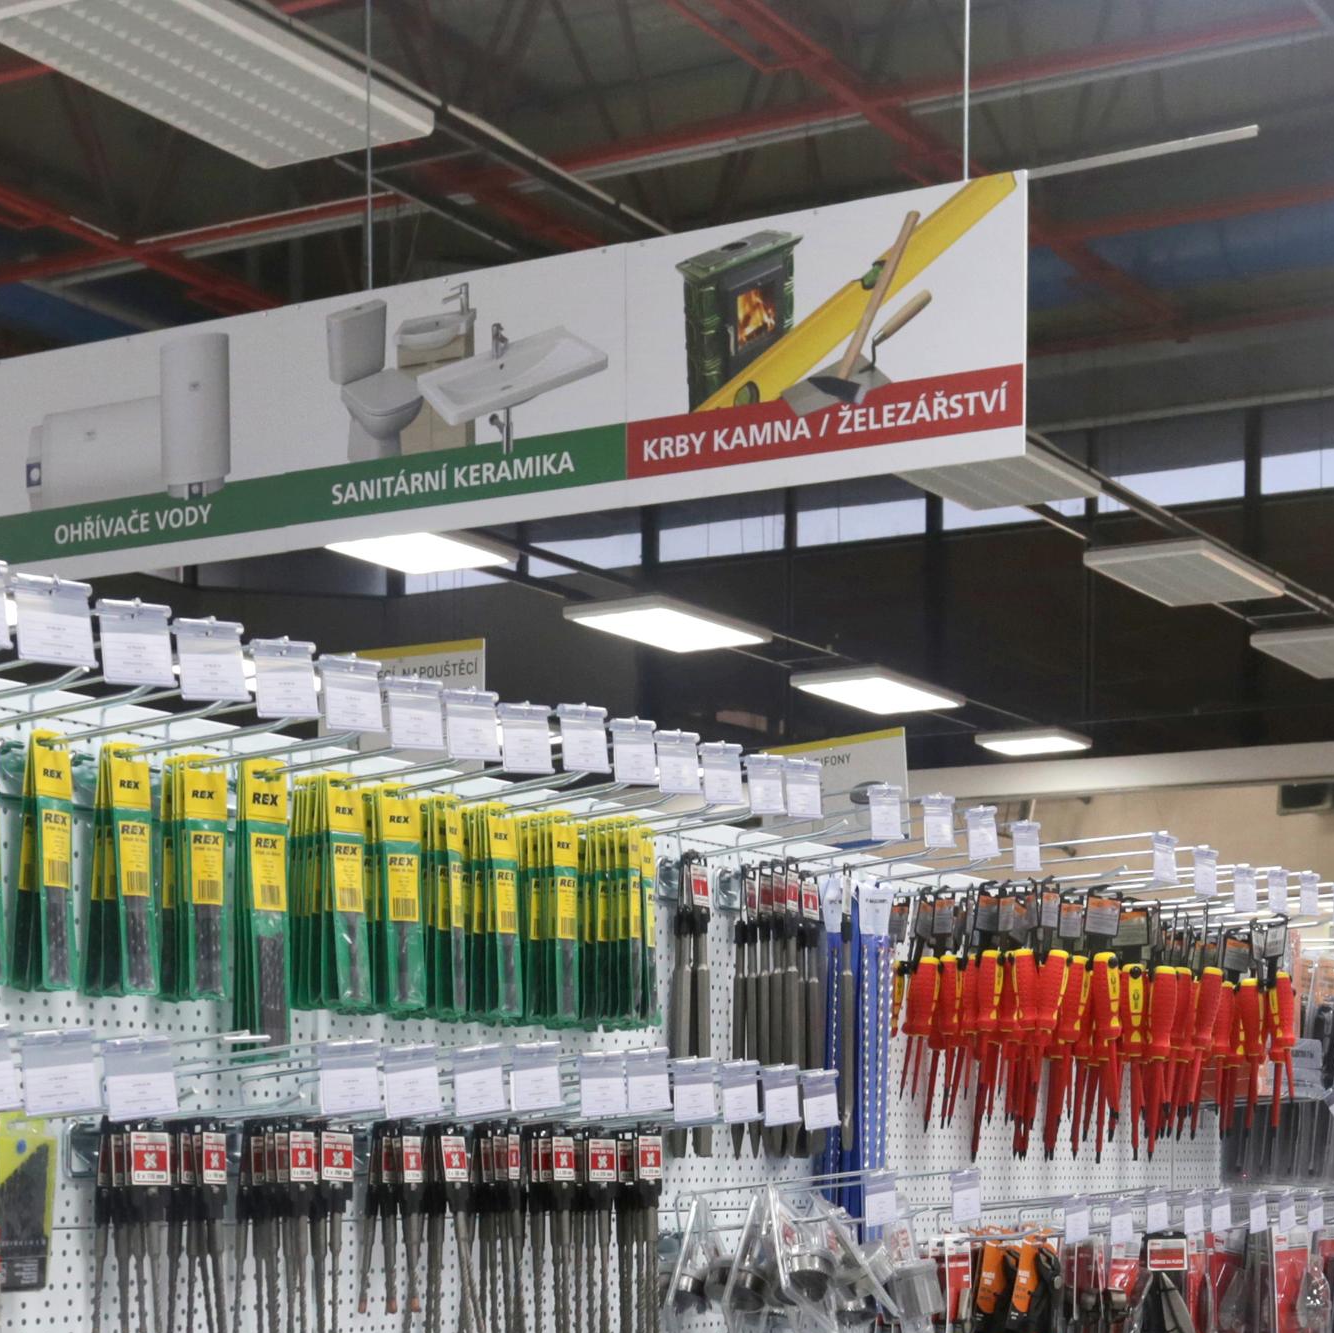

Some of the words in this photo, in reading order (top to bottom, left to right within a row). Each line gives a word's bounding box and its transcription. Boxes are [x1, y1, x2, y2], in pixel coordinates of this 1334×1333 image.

[642, 430, 707, 462] KRBY
[713, 415, 811, 452] KAMNA
[819, 413, 830, 437] /
[837, 381, 1010, 435] ŽELEZÁŘSTVÍ
[331, 461, 448, 506] SANITÁRNÍ
[453, 450, 576, 488] KERAMIKA
[54, 511, 150, 545] OHŘÍVAČE
[156, 503, 213, 534] VODY
[813, 753, 852, 767] IFONY
[43, 768, 63, 780] REX
[119, 779, 140, 790] REX
[192, 789, 216, 800] REX
[252, 792, 280, 807] REX
[335, 806, 355, 816] REX
[44, 812, 68, 826] REX
[389, 815, 411, 825] REX
[121, 824, 147, 836] REX
[494, 831, 509, 841] REX
[193, 834, 221, 845] REX
[255, 837, 279, 849] REX
[334, 845, 360, 857] REX
[388, 856, 414, 867] REX
